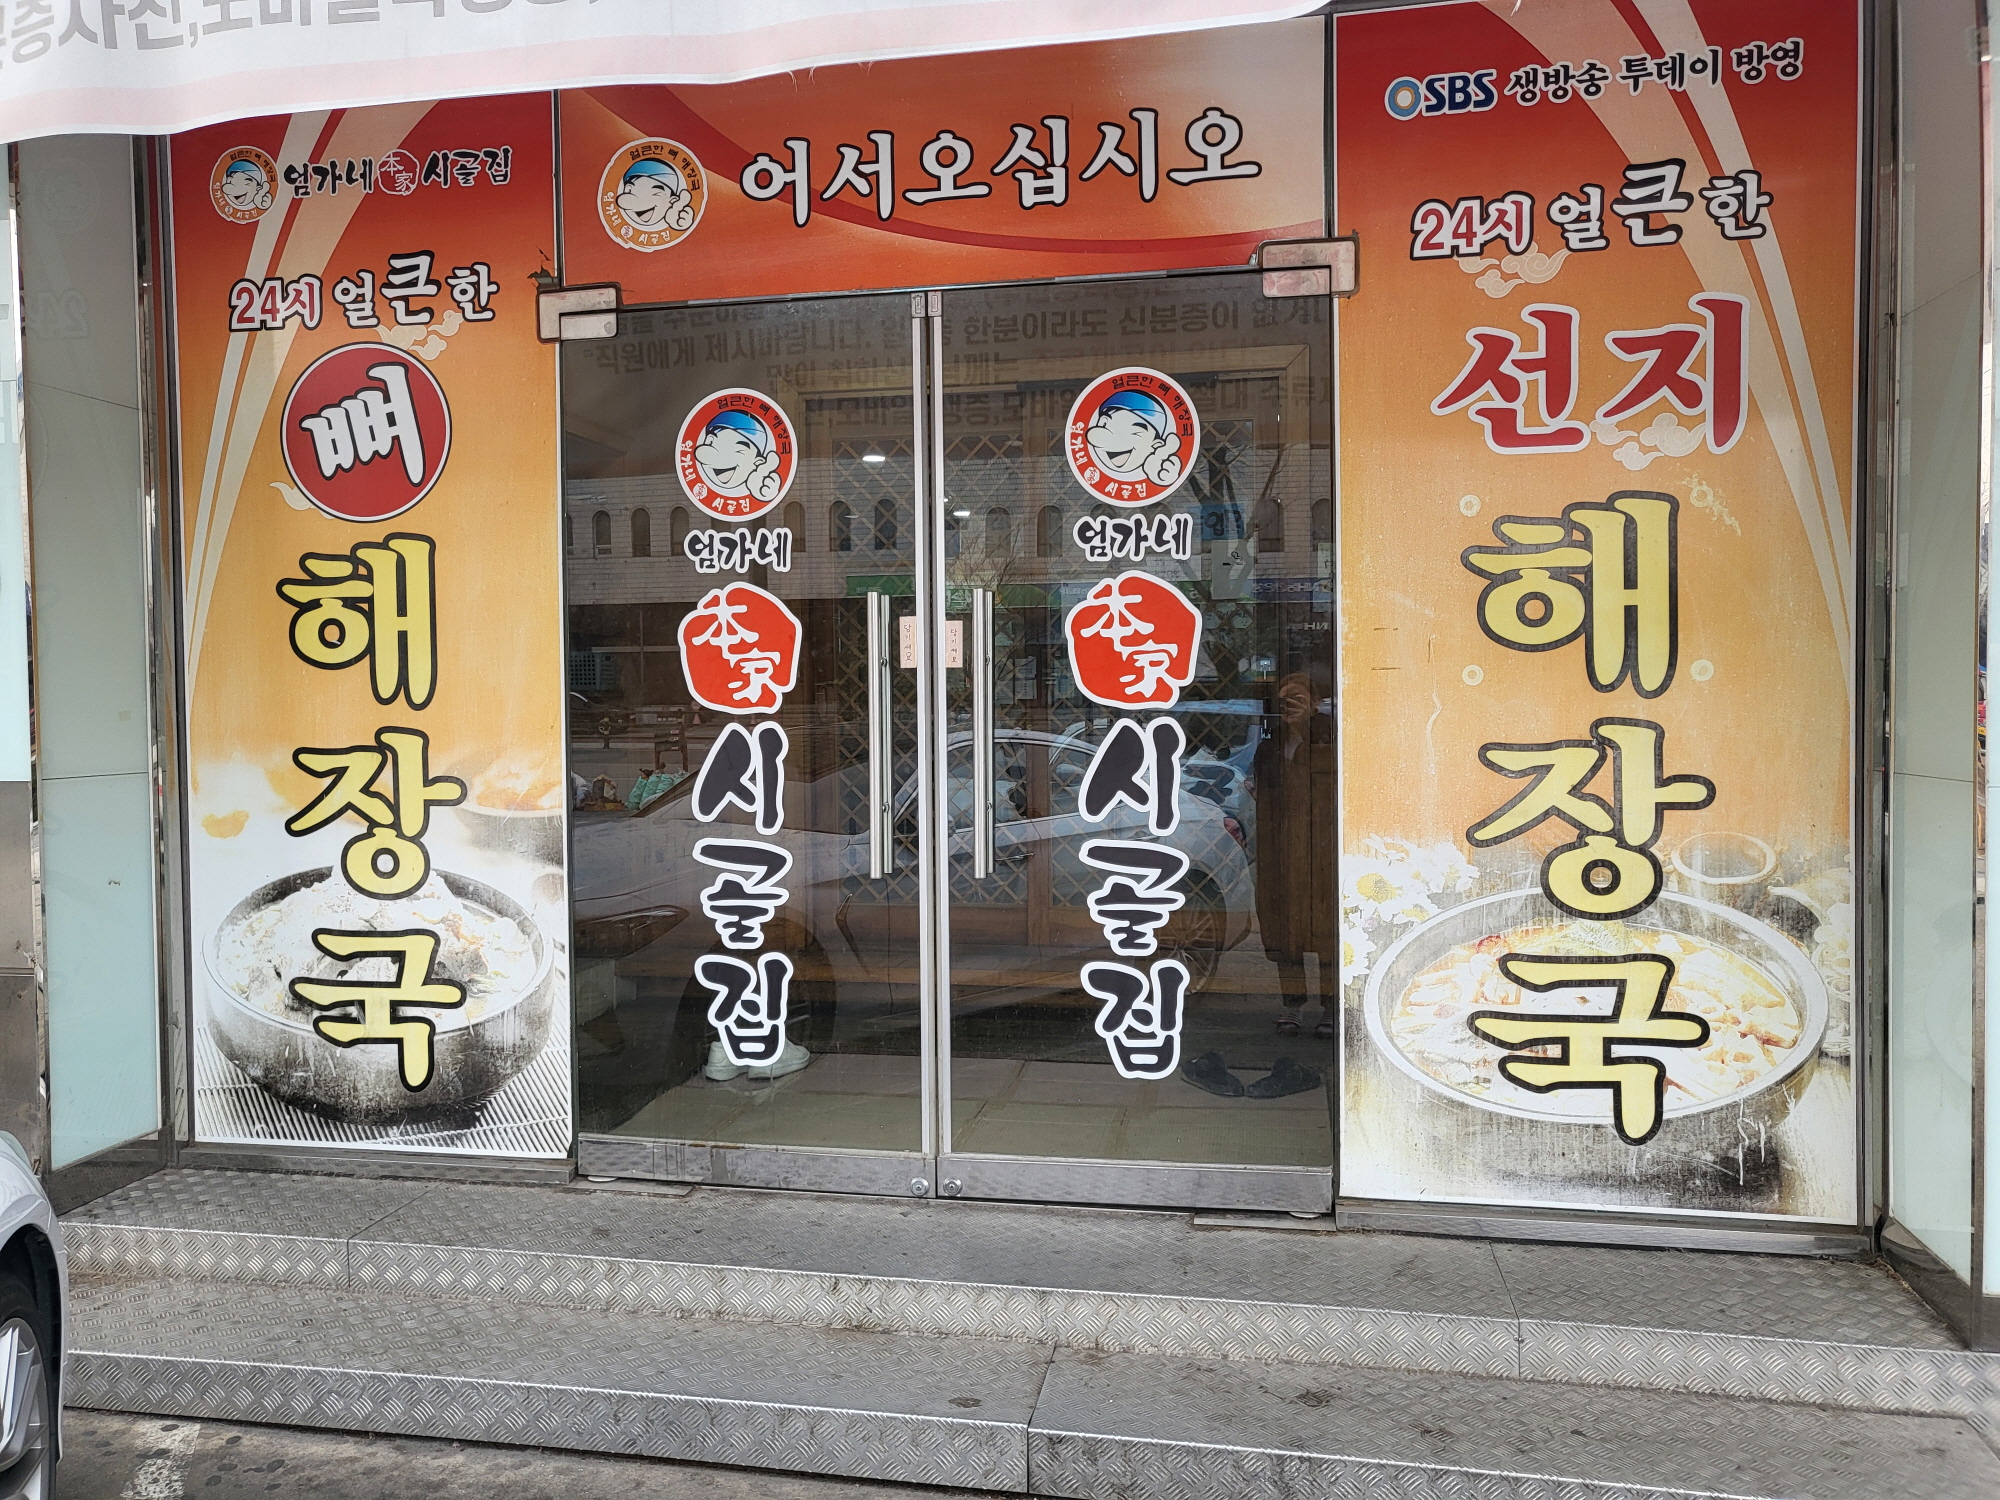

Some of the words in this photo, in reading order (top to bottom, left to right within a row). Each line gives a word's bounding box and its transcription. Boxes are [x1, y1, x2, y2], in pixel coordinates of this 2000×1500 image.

[1505, 59, 1609, 107] 생방송
[1618, 46, 1722, 97] 투데이
[1732, 38, 1803, 83] 방영
[284, 158, 373, 198] 엄가네
[422, 146, 512, 188] 시골집
[739, 107, 1262, 228] 어서오십시오
[1411, 192, 1534, 259] 24시
[1547, 158, 1772, 252] 얼큰한
[229, 275, 322, 331] 24시
[332, 249, 500, 329] 얼큰한
[300, 360, 426, 487] 뼈
[1431, 292, 1752, 455] 선지
[685, 529, 791, 572] 엄가네
[1074, 514, 1192, 560] 엄가네
[690, 588, 781, 704] 本家
[1079, 578, 1179, 699] 本家
[276, 532, 467, 1093] 해장국
[1460, 490, 1716, 1146] 해장국
[692, 721, 793, 1066] 시골집
[1080, 718, 1190, 1079] 시골집
